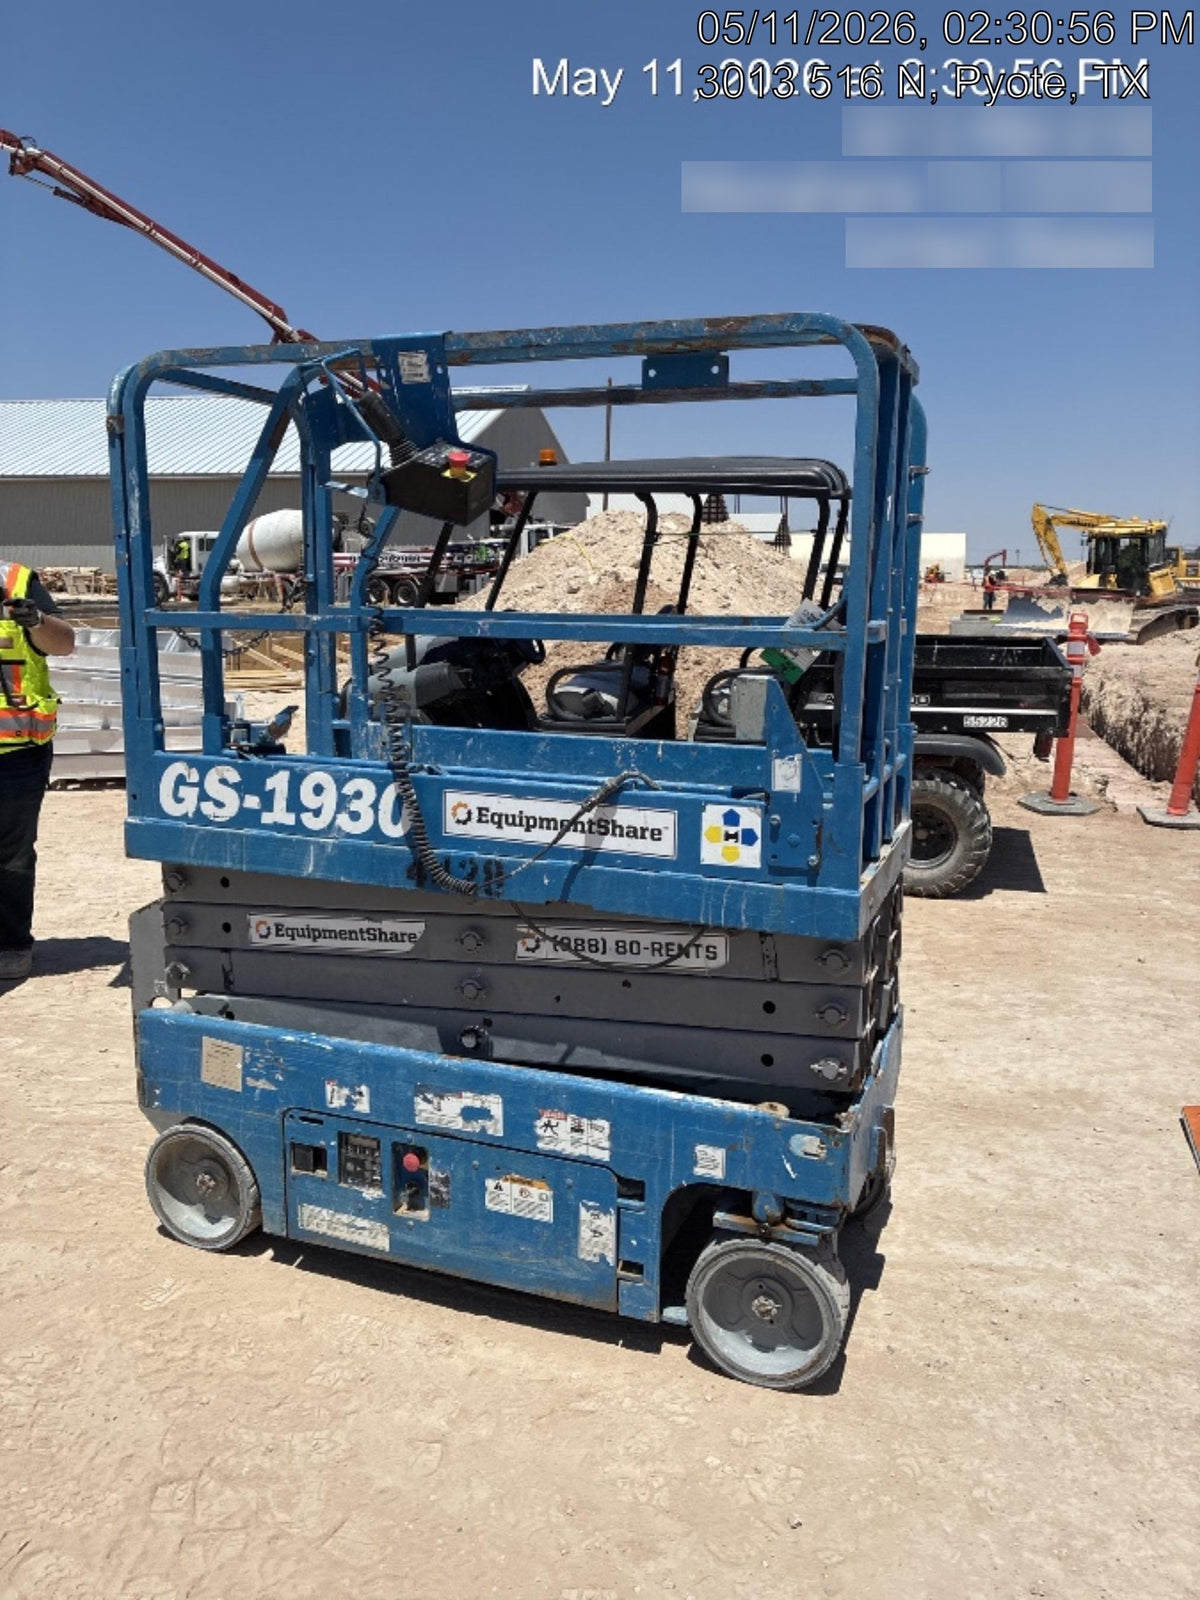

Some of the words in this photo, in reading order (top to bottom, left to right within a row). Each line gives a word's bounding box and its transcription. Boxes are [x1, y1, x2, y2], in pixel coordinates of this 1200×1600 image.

[158, 761, 413, 839] GS-1930
[475, 806, 664, 842] EquipmentShare
[273, 922, 419, 944] EquipmentShare
